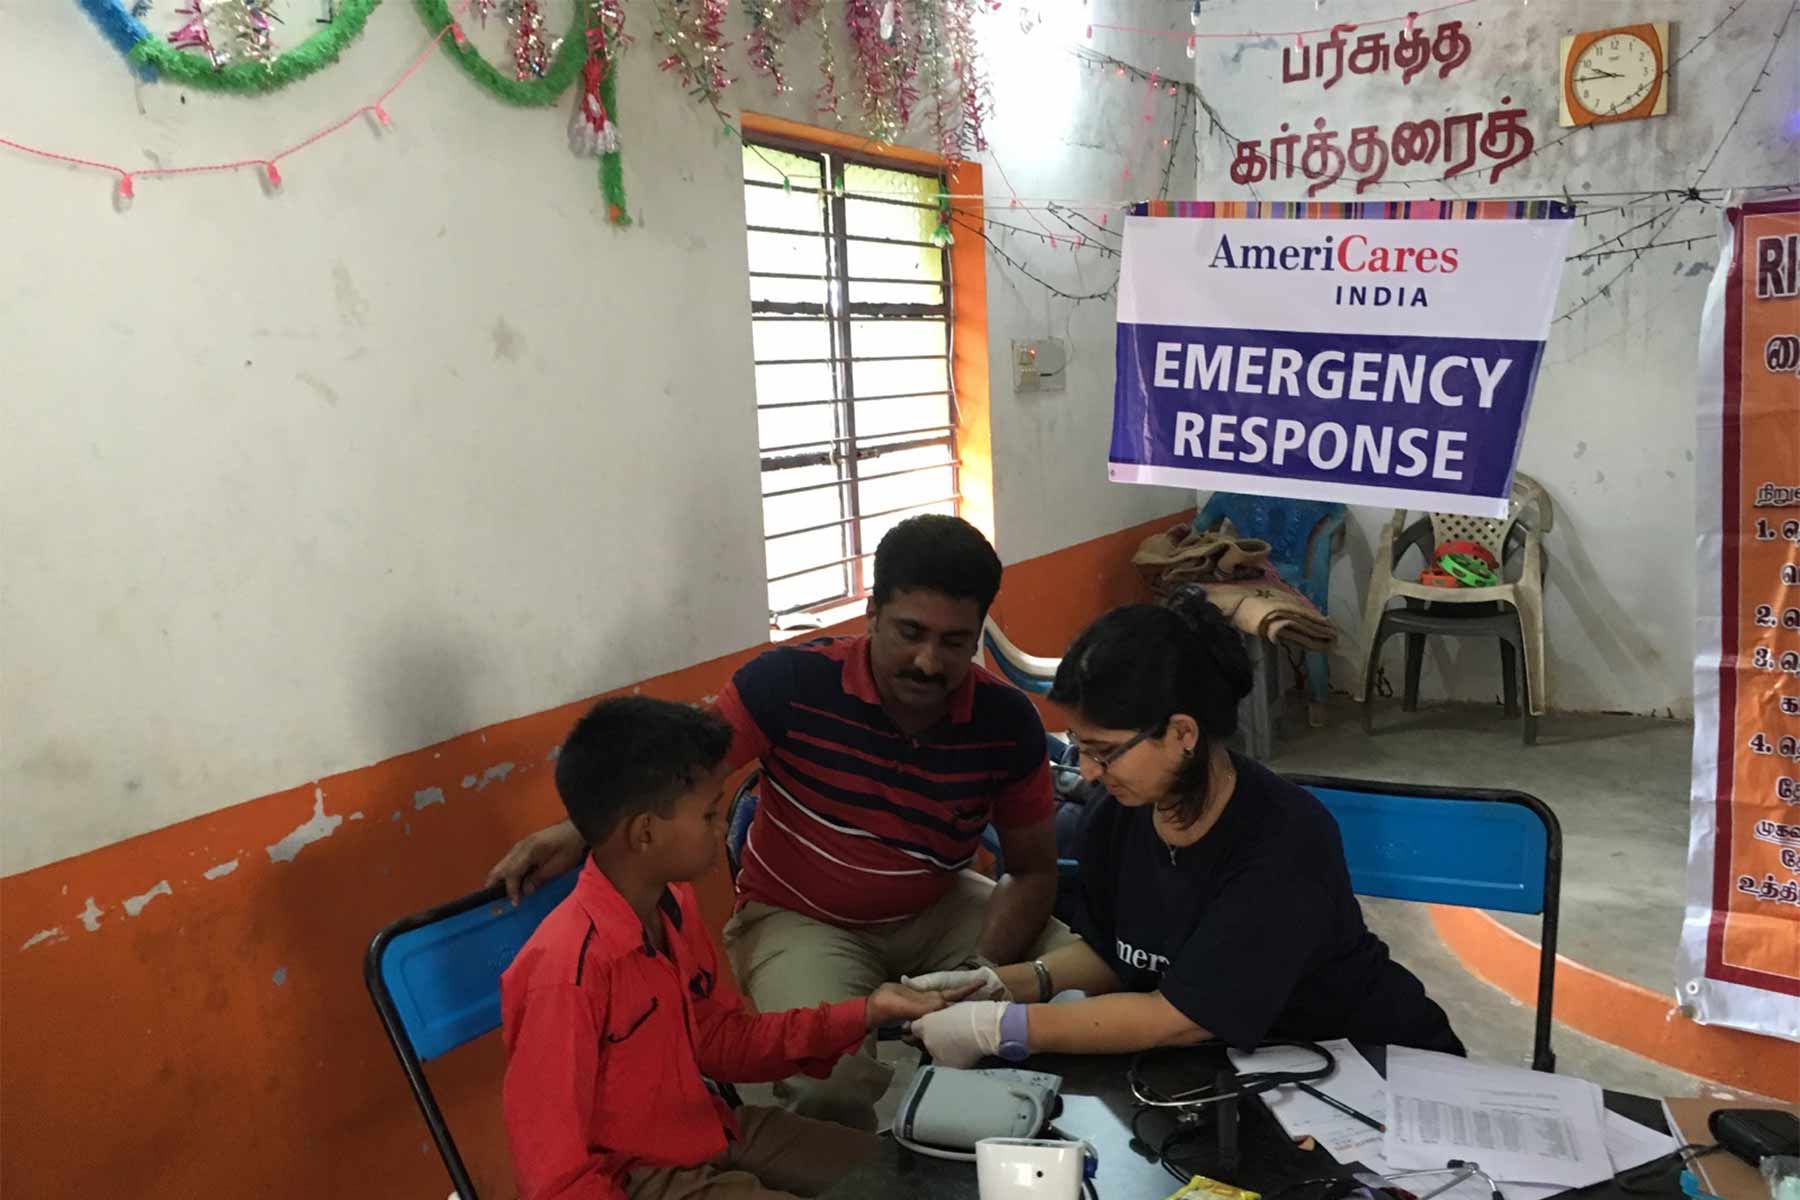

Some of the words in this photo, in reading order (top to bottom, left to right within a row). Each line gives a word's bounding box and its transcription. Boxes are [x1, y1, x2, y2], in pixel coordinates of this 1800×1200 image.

[1610, 40, 1620, 50] 12
[1583, 59, 1592, 68] 10
[1209, 233, 1459, 275] AmeriCares
[1757, 234, 1800, 297] RI
[1335, 286, 1429, 308] INDIA
[1153, 341, 1513, 409] EMERGENCY
[1173, 411, 1468, 481] RESPONSE
[1756, 605, 1777, 627] 2.
[1753, 646, 1774, 670] 3.
[1749, 733, 1773, 754] 4.
